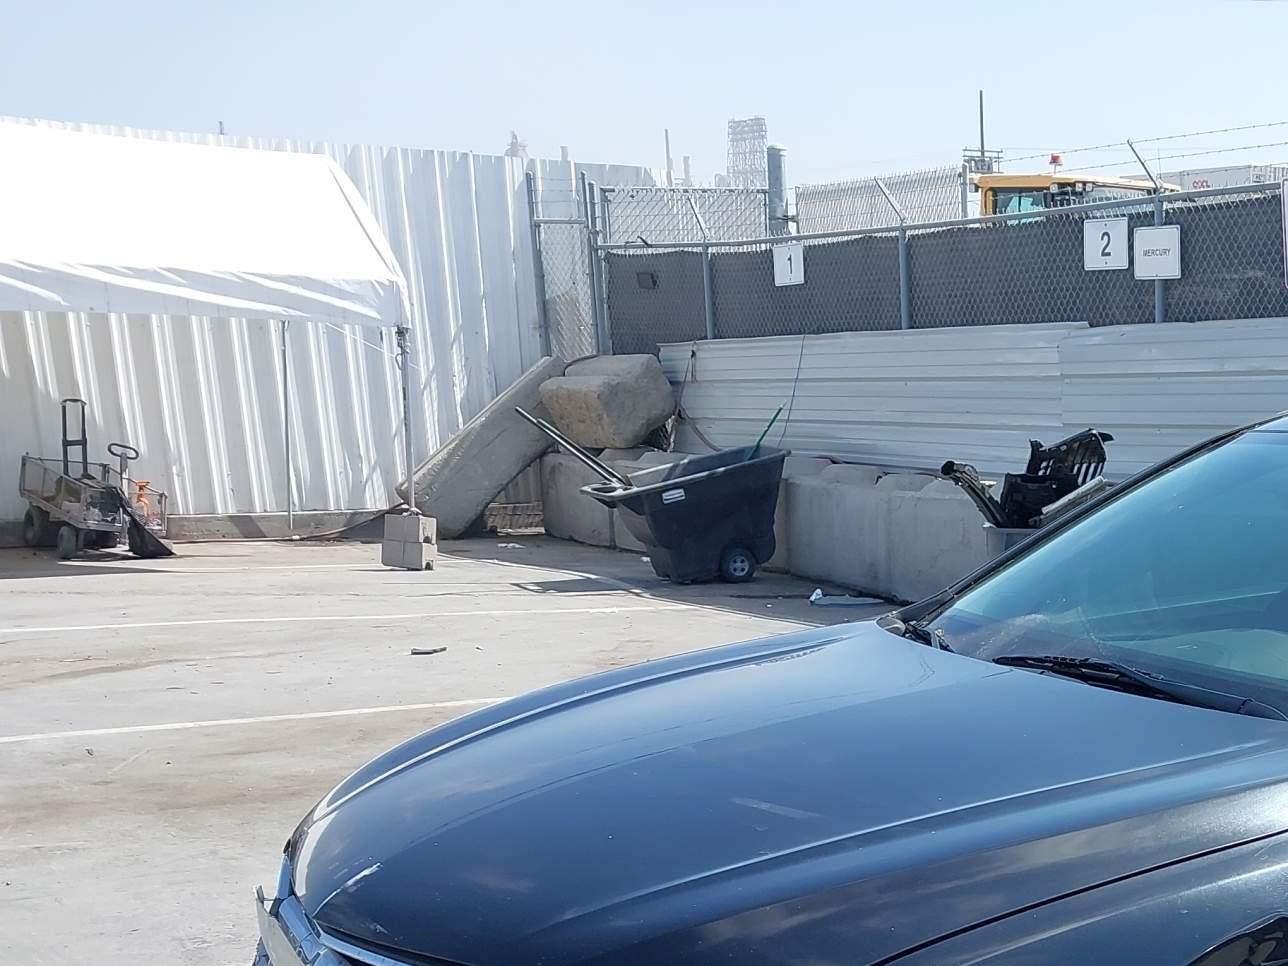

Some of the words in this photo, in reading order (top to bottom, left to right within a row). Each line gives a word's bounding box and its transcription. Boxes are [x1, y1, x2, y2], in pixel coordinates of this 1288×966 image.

[1100, 231, 1112, 257] 2
[1142, 248, 1171, 257] MERCURY
[787, 253, 793, 275] 1
